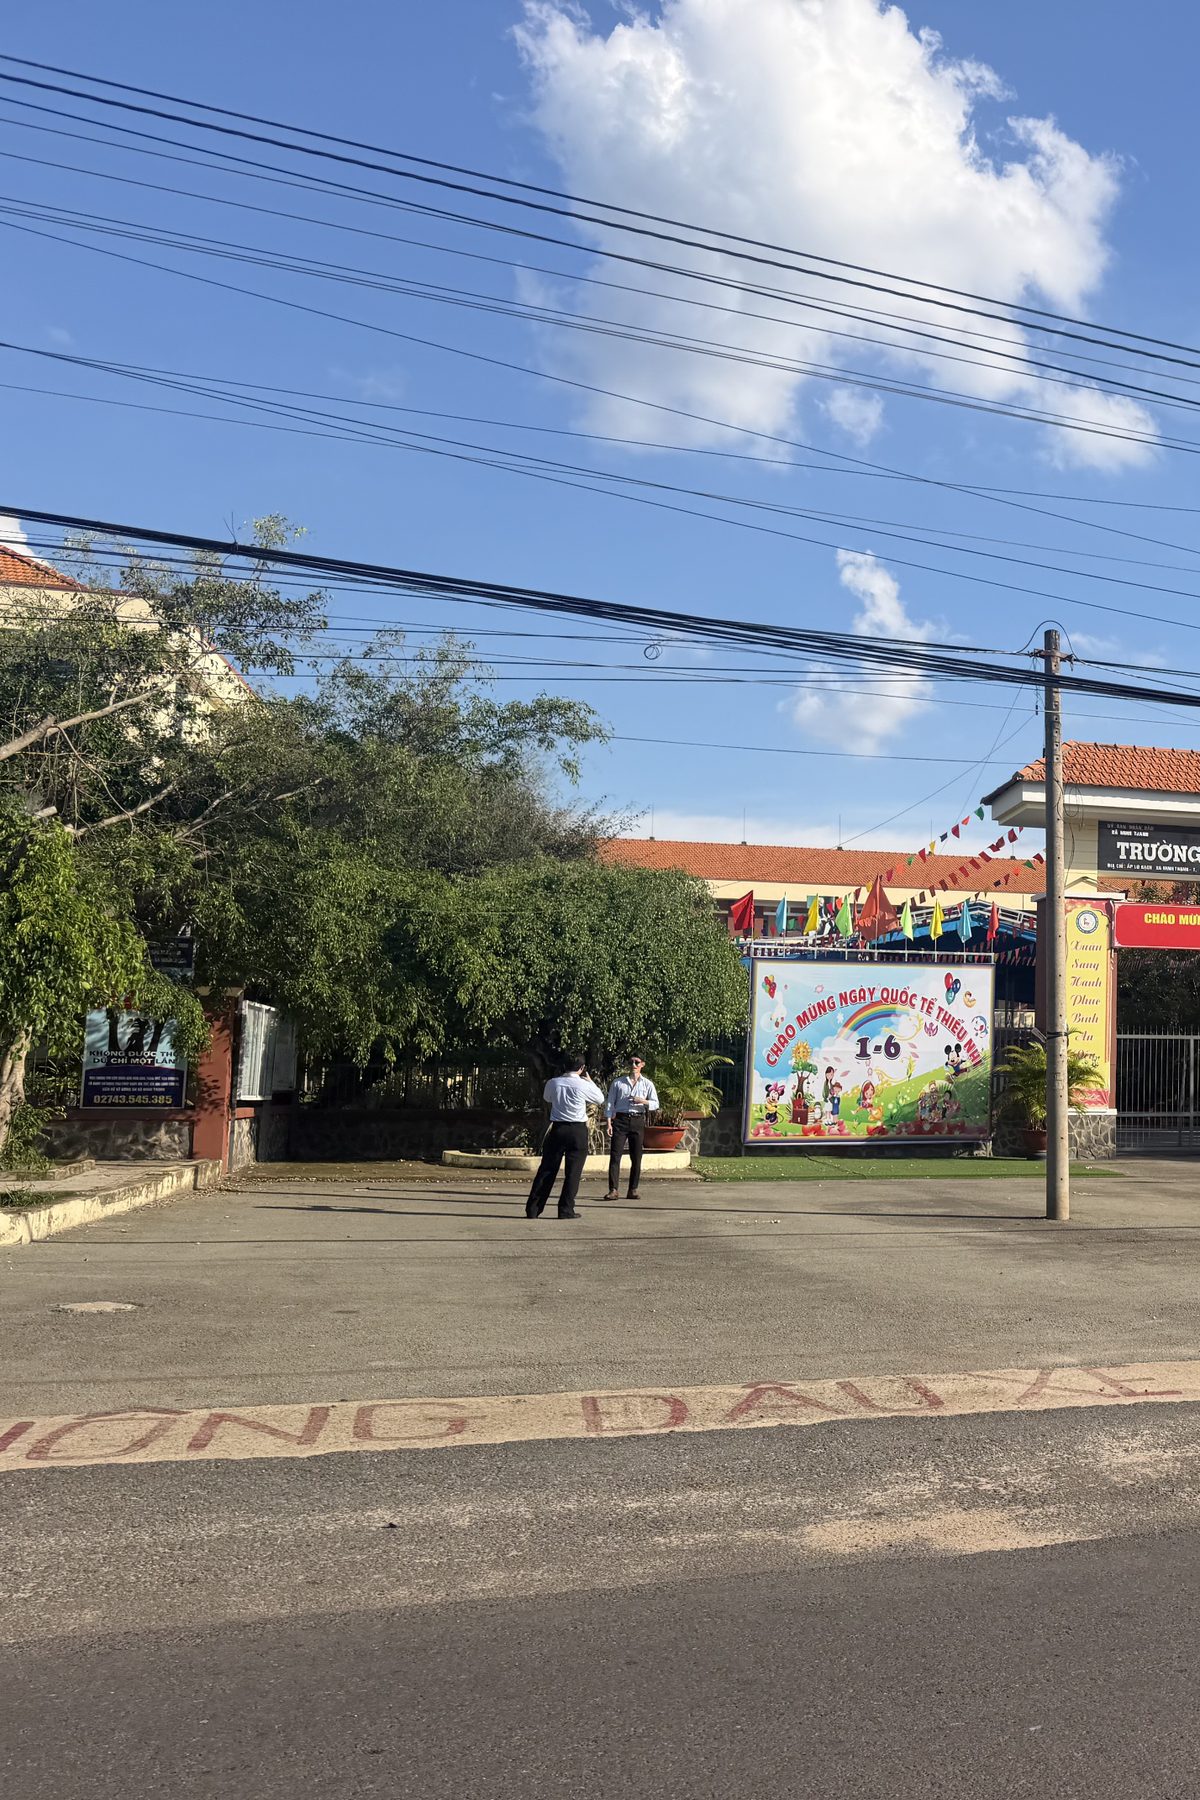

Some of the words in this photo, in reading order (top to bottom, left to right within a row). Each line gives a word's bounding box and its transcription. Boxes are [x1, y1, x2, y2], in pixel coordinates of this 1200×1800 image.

[1143, 912, 1176, 925] CHÀO
[765, 1024, 796, 1067] CHÀO
[795, 996, 837, 1031] MỪNG
[838, 985, 876, 1008] NGÀY
[880, 986, 918, 1009] QUỐC
[920, 997, 938, 1017] TẾ
[935, 1005, 968, 1042] THIẾU
[855, 1035, 901, 1061] 1-6
[93, 1094, 173, 1104] 02743.545.385
[965, 1364, 1183, 1406] XE
